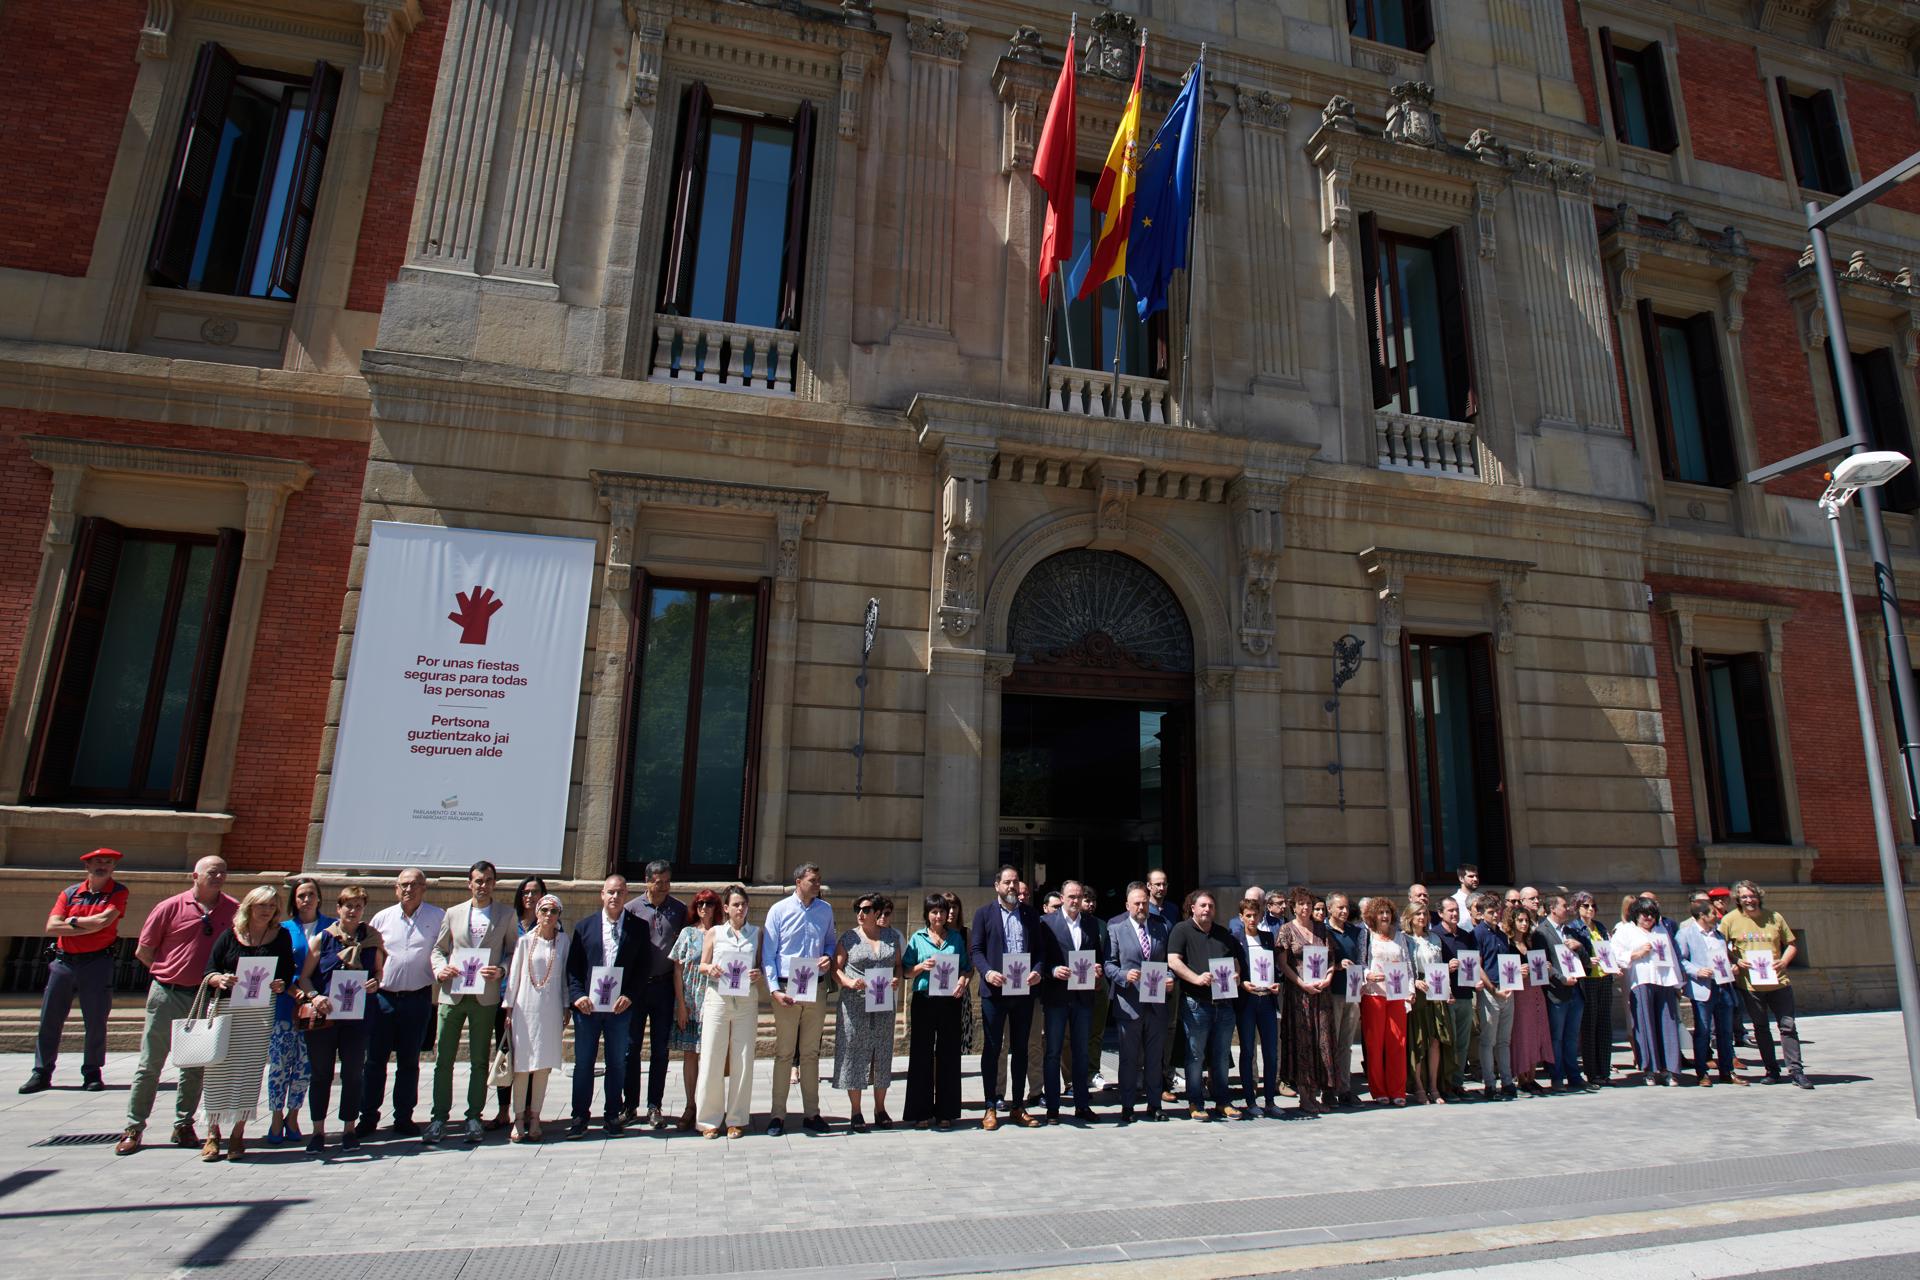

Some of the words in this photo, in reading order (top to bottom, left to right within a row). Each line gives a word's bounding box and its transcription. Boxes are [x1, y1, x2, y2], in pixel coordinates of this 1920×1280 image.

[416, 655, 440, 667] Por
[442, 658, 474, 669] unas
[477, 659, 520, 672] fiestas
[404, 670, 457, 683] seguras
[459, 674, 489, 684] para
[492, 674, 528, 686] todas
[423, 684, 442, 695] las
[445, 687, 505, 699] personas
[431, 715, 490, 728] Pertsona
[407, 729, 491, 743] guztientzako
[493, 732, 510, 745] jai
[410, 744, 472, 757] seguruen
[475, 746, 503, 758] alde
